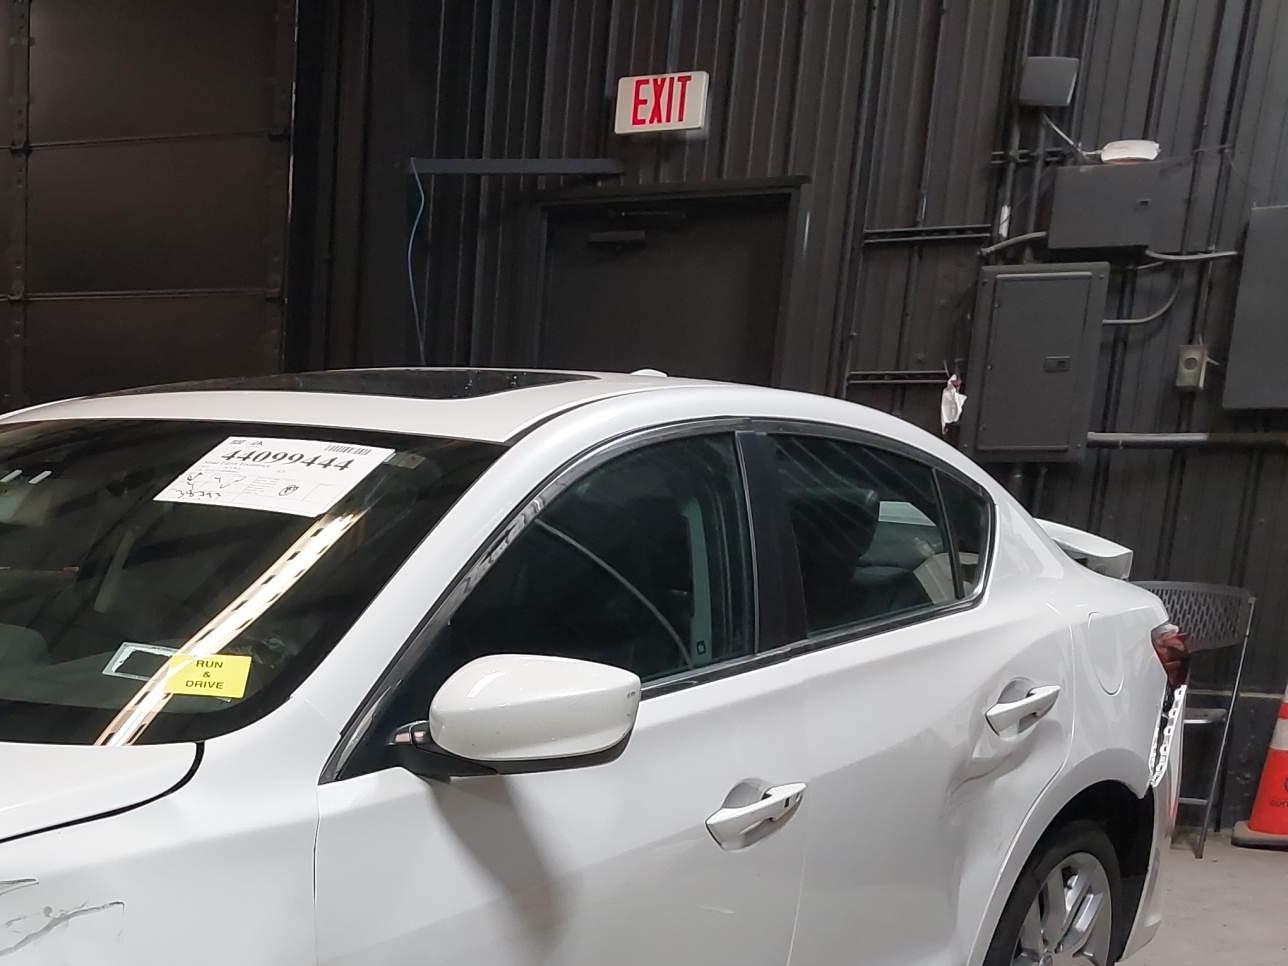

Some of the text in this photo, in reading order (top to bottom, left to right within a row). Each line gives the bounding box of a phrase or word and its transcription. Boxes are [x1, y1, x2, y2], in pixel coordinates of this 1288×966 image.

[632, 75, 692, 126] EXIT
[221, 449, 355, 471] 44099444
[195, 659, 224, 669] RUN
[185, 680, 225, 690] DRIVE
